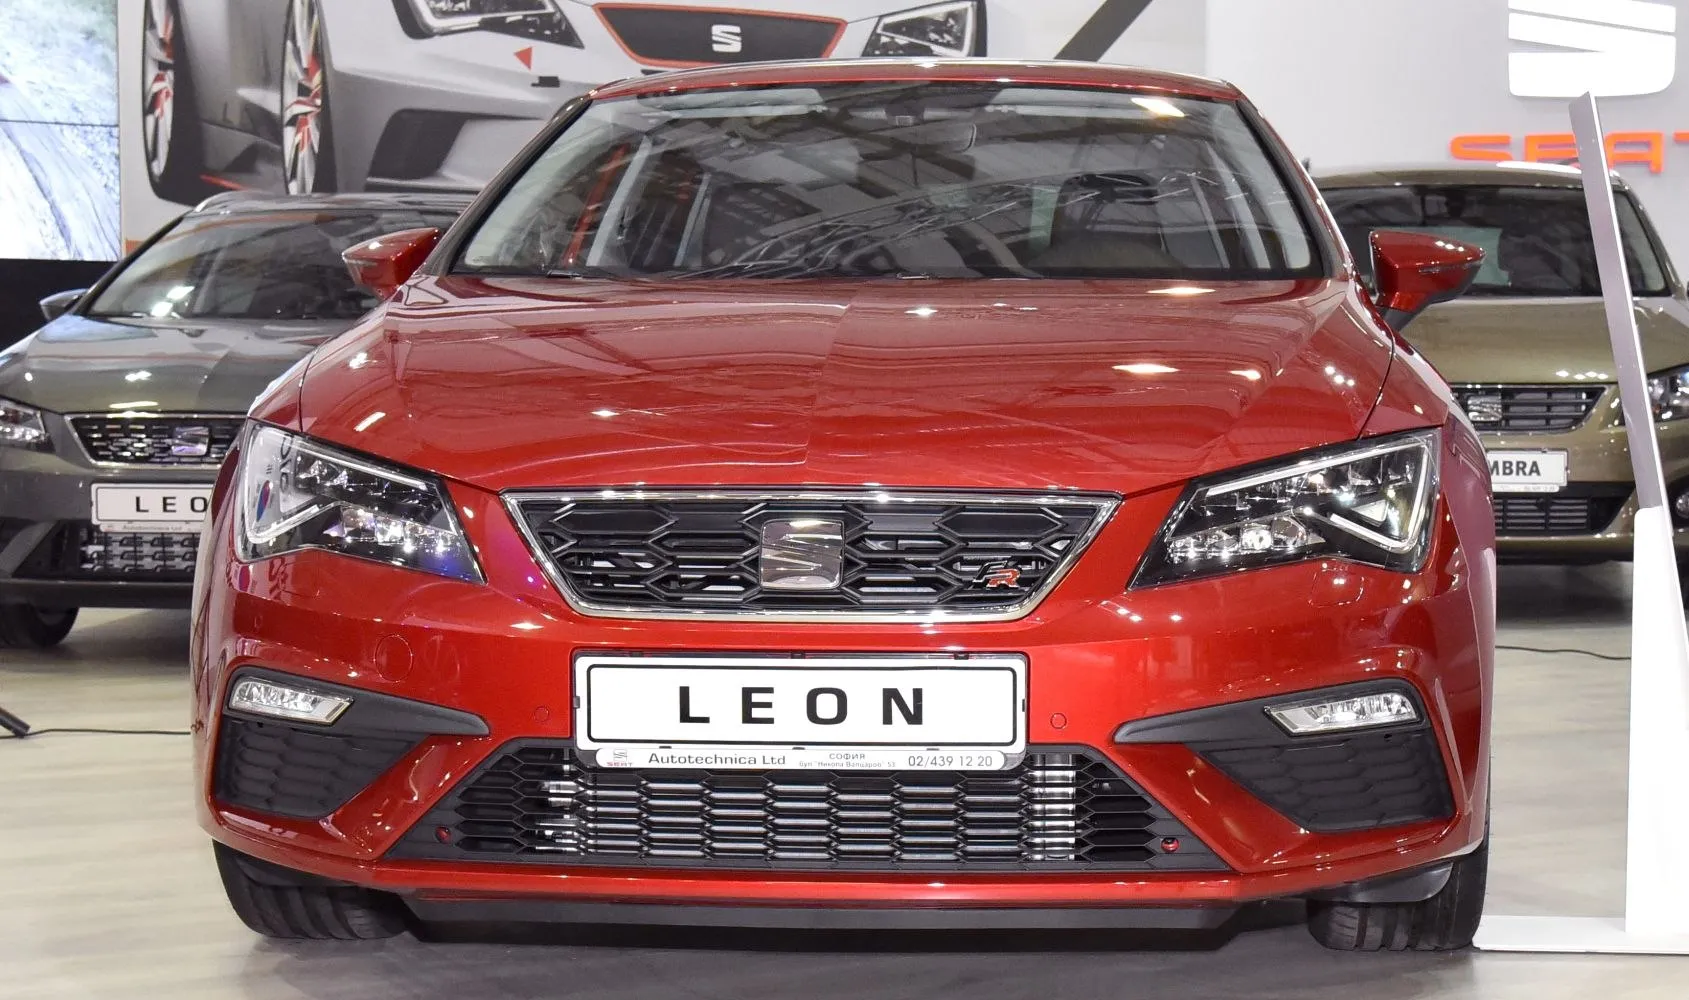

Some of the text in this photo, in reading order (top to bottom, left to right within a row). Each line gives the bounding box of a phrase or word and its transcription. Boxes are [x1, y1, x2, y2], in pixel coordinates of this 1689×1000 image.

[1449, 131, 1689, 174] SEA
[135, 496, 208, 513] LEO
[679, 686, 923, 725] LEON
[648, 752, 786, 766] Autotechnica Ltd
[908, 755, 993, 768] 02/439 12 20
